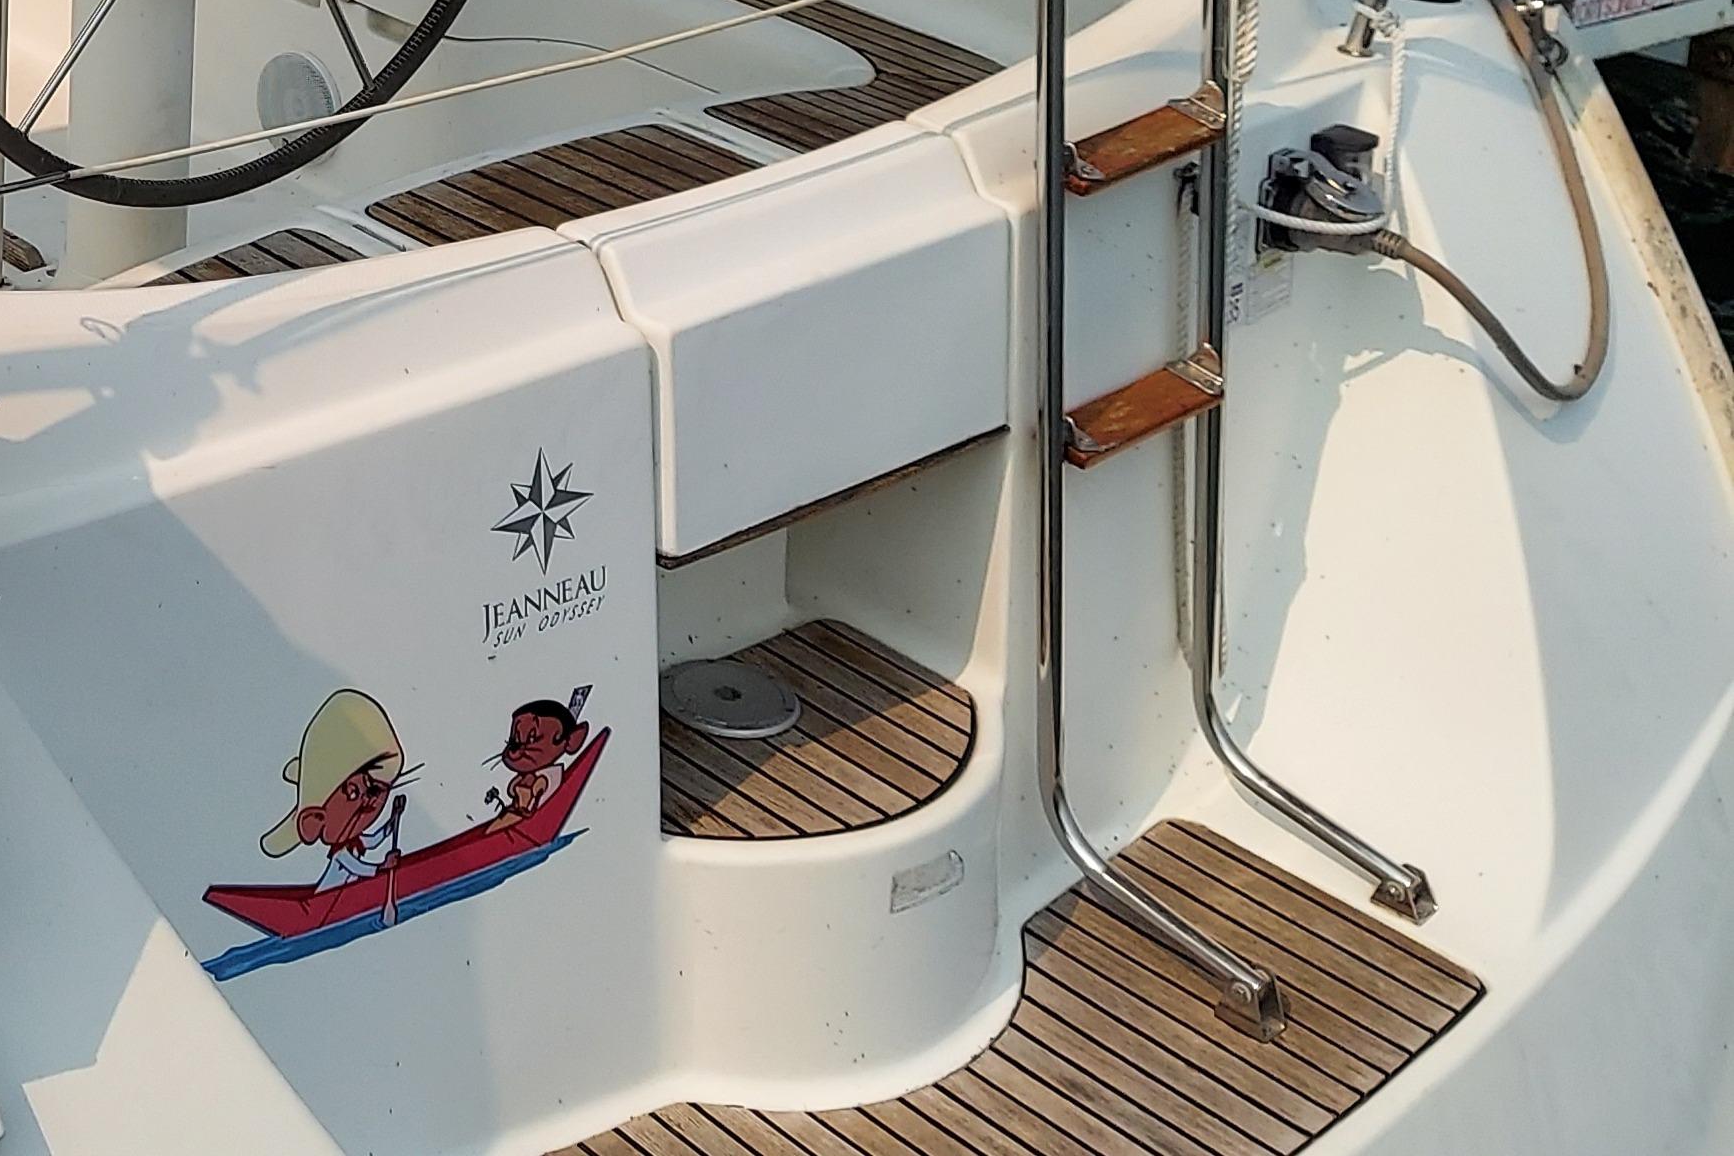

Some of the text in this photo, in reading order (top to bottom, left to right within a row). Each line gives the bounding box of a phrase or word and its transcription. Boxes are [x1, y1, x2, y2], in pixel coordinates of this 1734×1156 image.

[482, 565, 606, 644] JEANNEAU
[493, 595, 605, 648] SUN ODYSSEY
